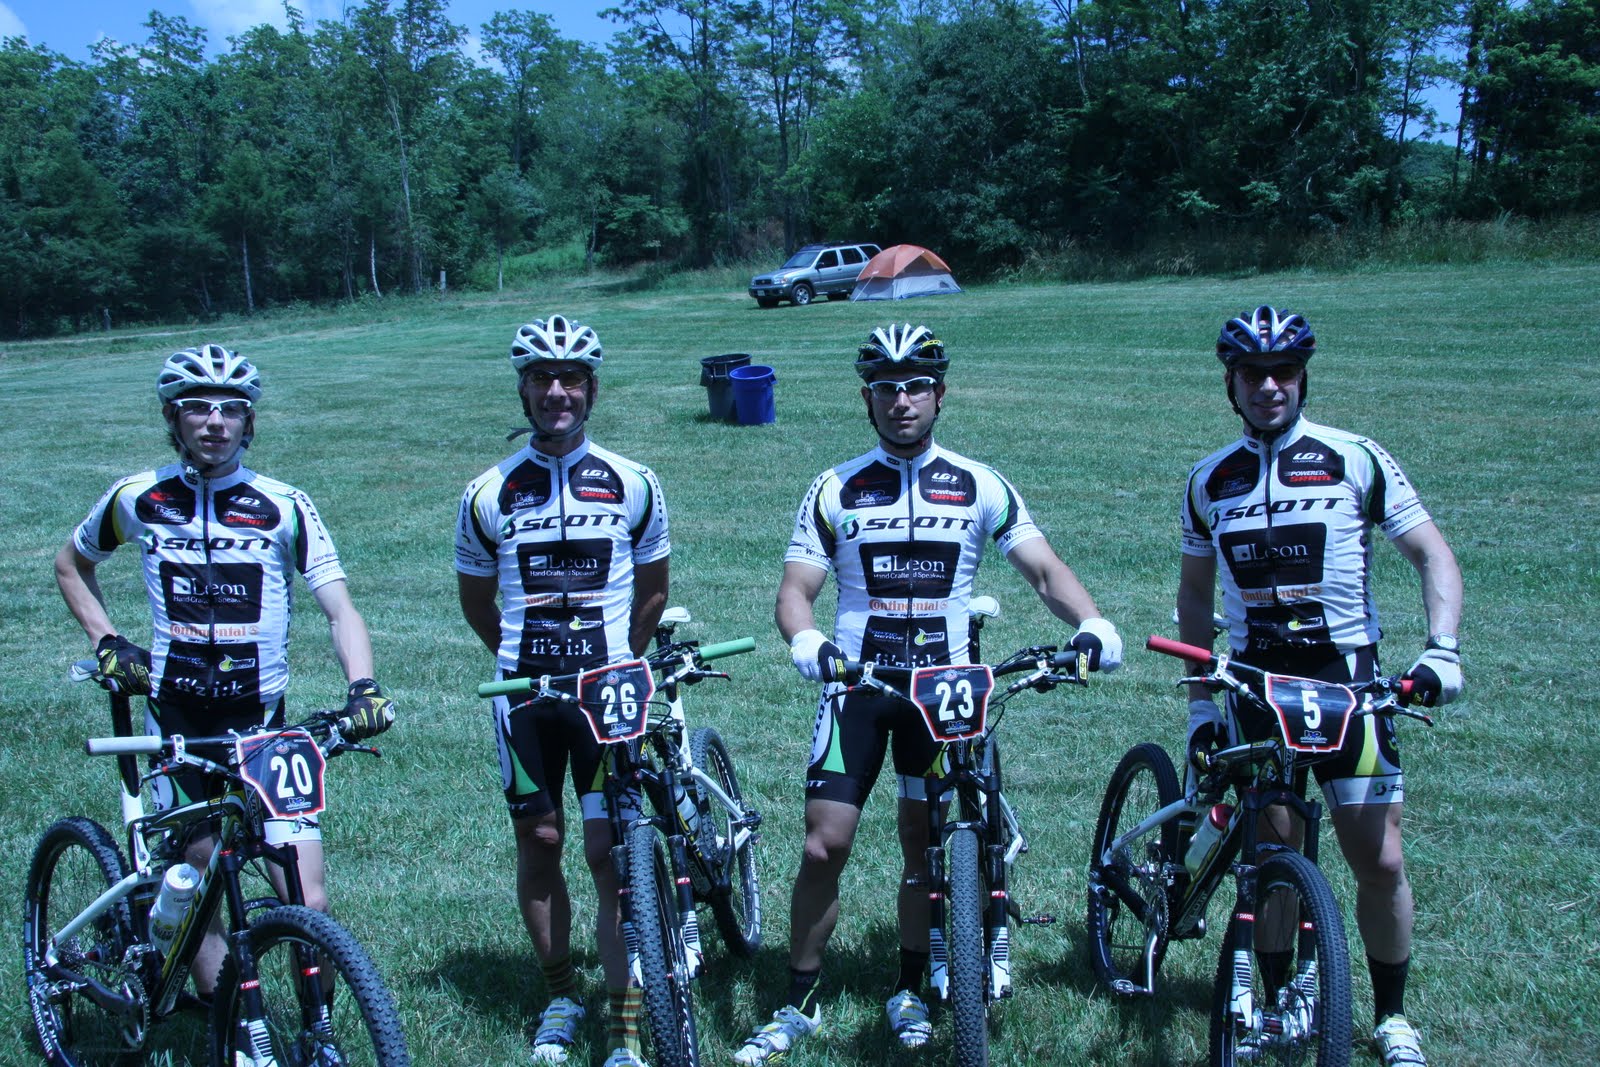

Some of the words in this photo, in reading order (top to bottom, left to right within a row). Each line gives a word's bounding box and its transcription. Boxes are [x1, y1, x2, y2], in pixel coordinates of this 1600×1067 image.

[1221, 497, 1345, 522] SCOTT
[518, 514, 626, 532] SCOTT
[862, 516, 977, 531] SCOTT
[161, 537, 273, 551] SCOTT
[892, 555, 945, 572] Leon
[191, 577, 248, 596] Leon
[600, 683, 638, 725] 26
[935, 679, 974, 722] 23
[1301, 690, 1321, 729] 5
[270, 753, 313, 799] 20
